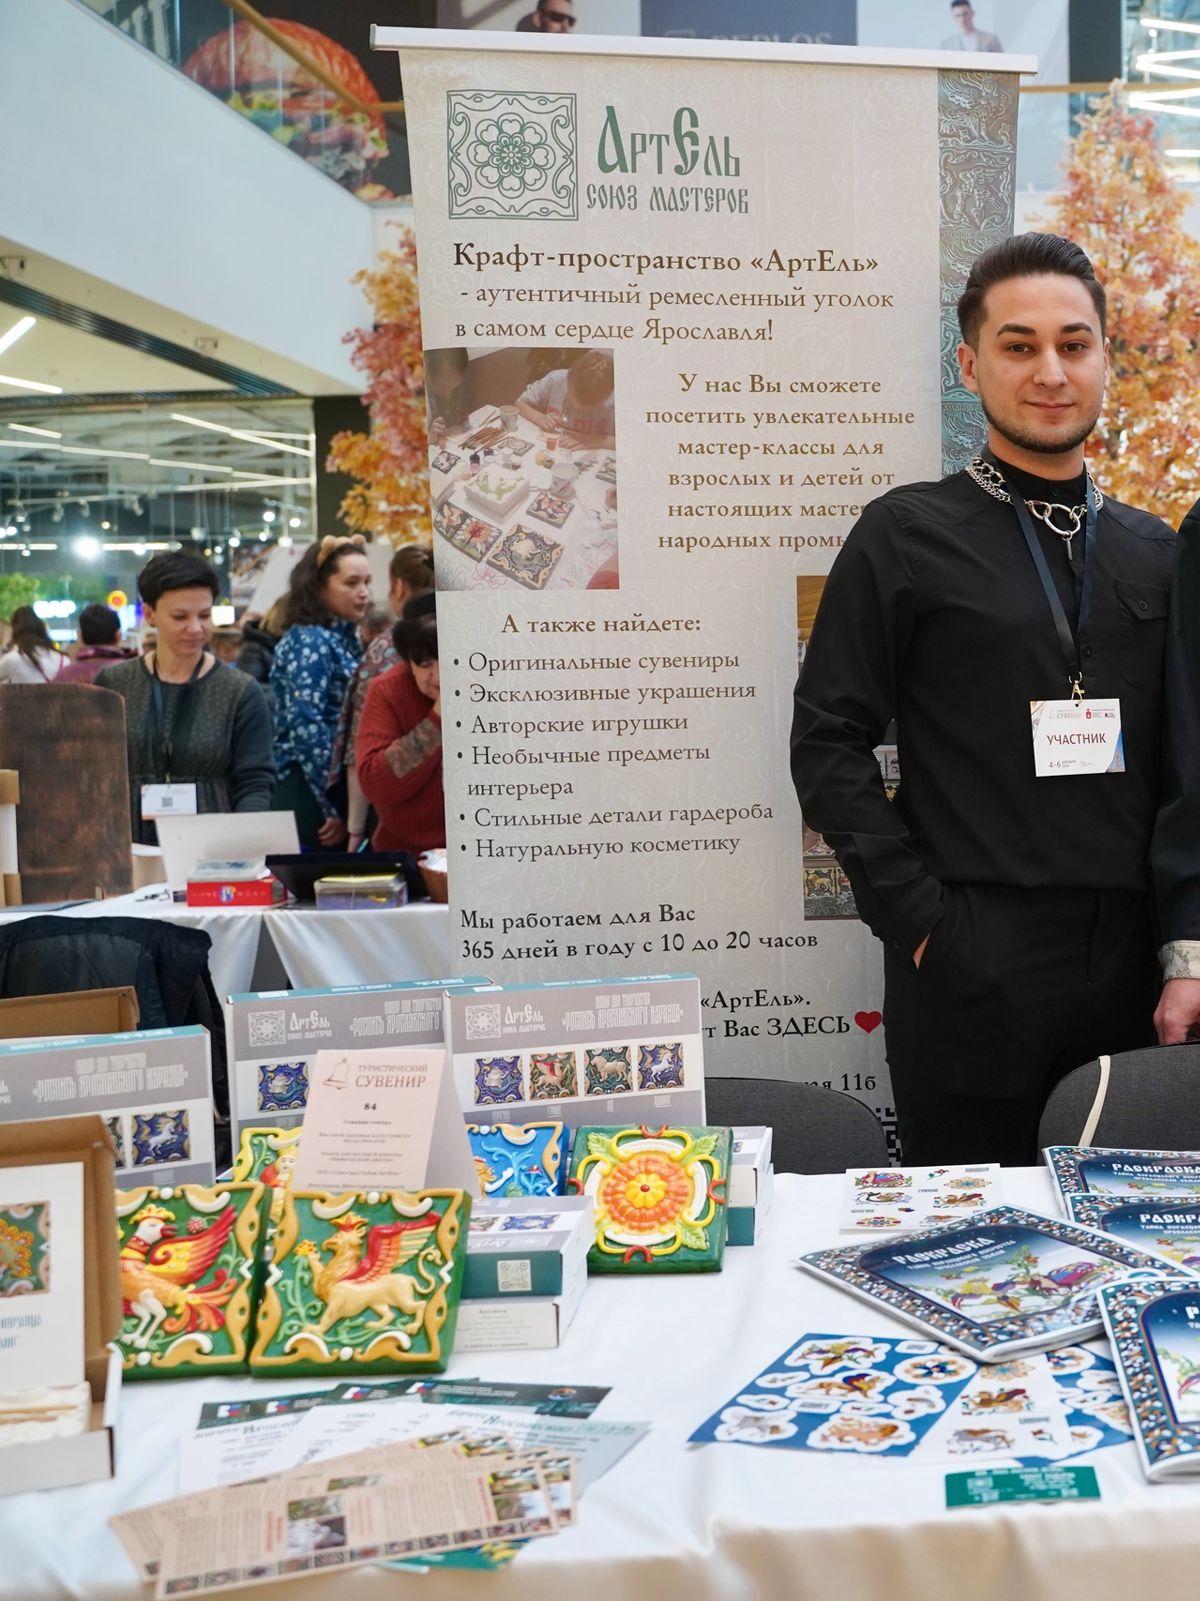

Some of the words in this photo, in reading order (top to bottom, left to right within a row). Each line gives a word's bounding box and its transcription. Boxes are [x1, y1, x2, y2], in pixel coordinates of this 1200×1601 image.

[452, 242, 741, 275] Крафт-пространство
[750, 248, 879, 279] «АртЕль»
[476, 282, 641, 308] аутентичный
[649, 286, 806, 311] ремесленный
[812, 294, 894, 313] уголок
[455, 324, 467, 337] в
[473, 323, 547, 337] самом
[554, 324, 634, 344] сердце
[642, 318, 773, 346] Ярославля!
[678, 373, 698, 393] У
[705, 381, 742, 393] нас
[748, 374, 782, 393] Вы
[789, 381, 882, 393] сможете
[646, 411, 746, 424] посетить
[752, 412, 915, 429] увлекательные
[678, 442, 836, 461] мастер-классы
[842, 443, 884, 457] для
[668, 474, 772, 491] взрослых
[779, 474, 794, 486] и
[800, 466, 864, 487] детей
[871, 473, 895, 486] от
[667, 504, 793, 518] настоящих
[800, 503, 864, 517] масте
[658, 536, 771, 553] народных
[779, 534, 846, 552] промы
[500, 614, 520, 634] А
[526, 620, 596, 633] также
[603, 612, 701, 633] найдете:
[468, 651, 631, 677] Оригинальные
[638, 655, 740, 674] сувениры
[469, 683, 631, 703] Эксклюзивные
[637, 686, 757, 705] украшения
[471, 714, 584, 739] Авторские
[591, 717, 688, 737] игрушки
[1047, 733, 1107, 745] УЧАСТНИК
[471, 745, 600, 765] Необычные
[607, 748, 711, 767] предметы
[467, 782, 574, 801] интерьера
[474, 807, 583, 827] Стильные
[588, 810, 663, 826] детали
[669, 803, 774, 826] гардероба
[475, 838, 624, 863] Натуральную
[630, 838, 741, 855] косметику
[460, 909, 495, 929] Мы
[502, 912, 602, 934] работаем
[609, 911, 652, 926] для
[658, 903, 696, 923] Вас
[462, 939, 494, 960] 365
[501, 939, 559, 961] дней
[566, 945, 578, 957] в
[585, 942, 636, 959] году
[642, 941, 653, 953] с
[660, 933, 685, 952] 10
[691, 938, 719, 952] до
[725, 930, 751, 950] 20
[758, 935, 818, 948] часов
[700, 989, 811, 1013] «АртЕль».
[723, 1019, 760, 1038] Вас
[766, 1015, 851, 1038] ЗДЕСЬ
[358, 1063, 428, 1074] ТУРИСТИЧЕСКИЙ
[355, 1075, 427, 1089] СУВЕНИР
[841, 1072, 877, 1091] 11б
[364, 1102, 377, 1110] 84
[892, 1237, 995, 1264] РАСКРАСКА
